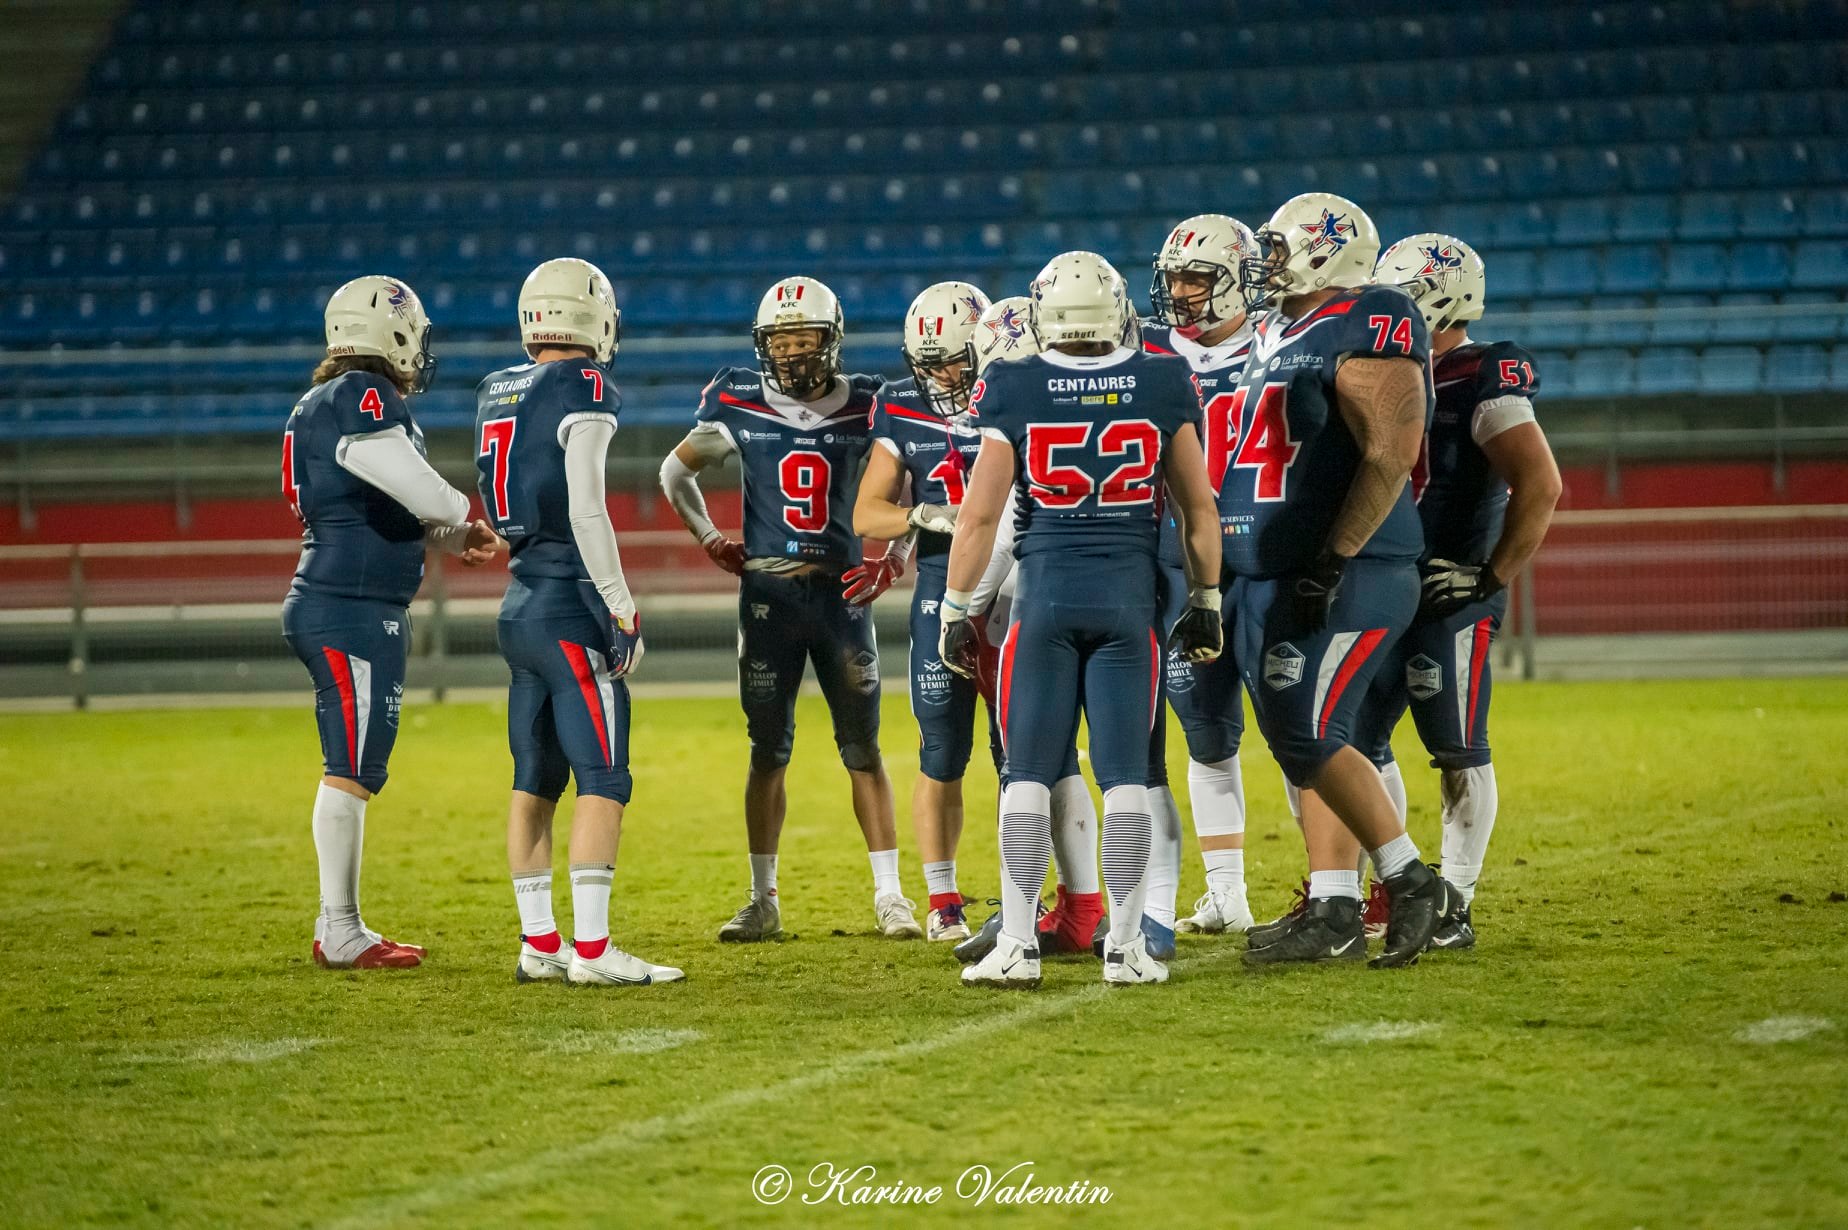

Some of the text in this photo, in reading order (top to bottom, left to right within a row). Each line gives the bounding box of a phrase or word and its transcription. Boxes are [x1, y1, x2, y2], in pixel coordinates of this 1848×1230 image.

[1169, 248, 1181, 256] KFC
[532, 333, 572, 342] Riddell
[1369, 315, 1413, 354] 74
[489, 375, 534, 395] CENTAURES
[581, 369, 602, 402] 7
[1047, 375, 1137, 392] CENTAURES
[1499, 359, 1534, 391] 51
[359, 387, 384, 421] 4
[479, 417, 517, 521] 7
[1026, 418, 1162, 509] 52
[778, 450, 832, 534] 9
[917, 672, 953, 682] LE SALON
